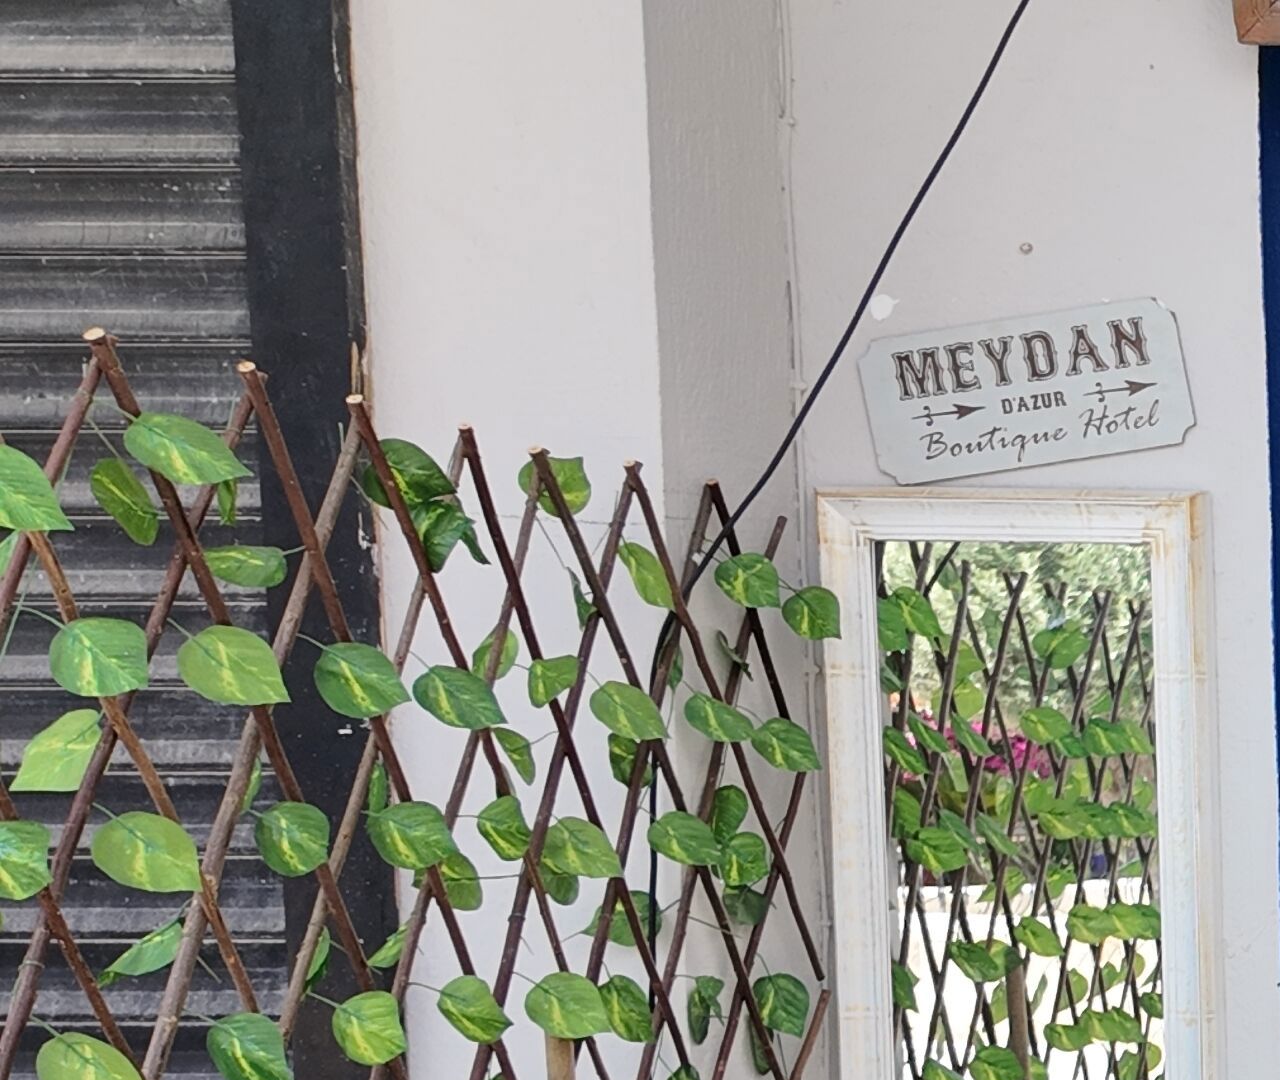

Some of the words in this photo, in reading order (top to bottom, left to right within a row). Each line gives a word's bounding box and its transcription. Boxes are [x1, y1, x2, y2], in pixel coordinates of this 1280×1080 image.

[891, 316, 1152, 401] MEYDAN
[919, 426, 1068, 463] Boutique
[1078, 399, 1160, 439] Hotel
[1001, 391, 1067, 415] D'AZUR
